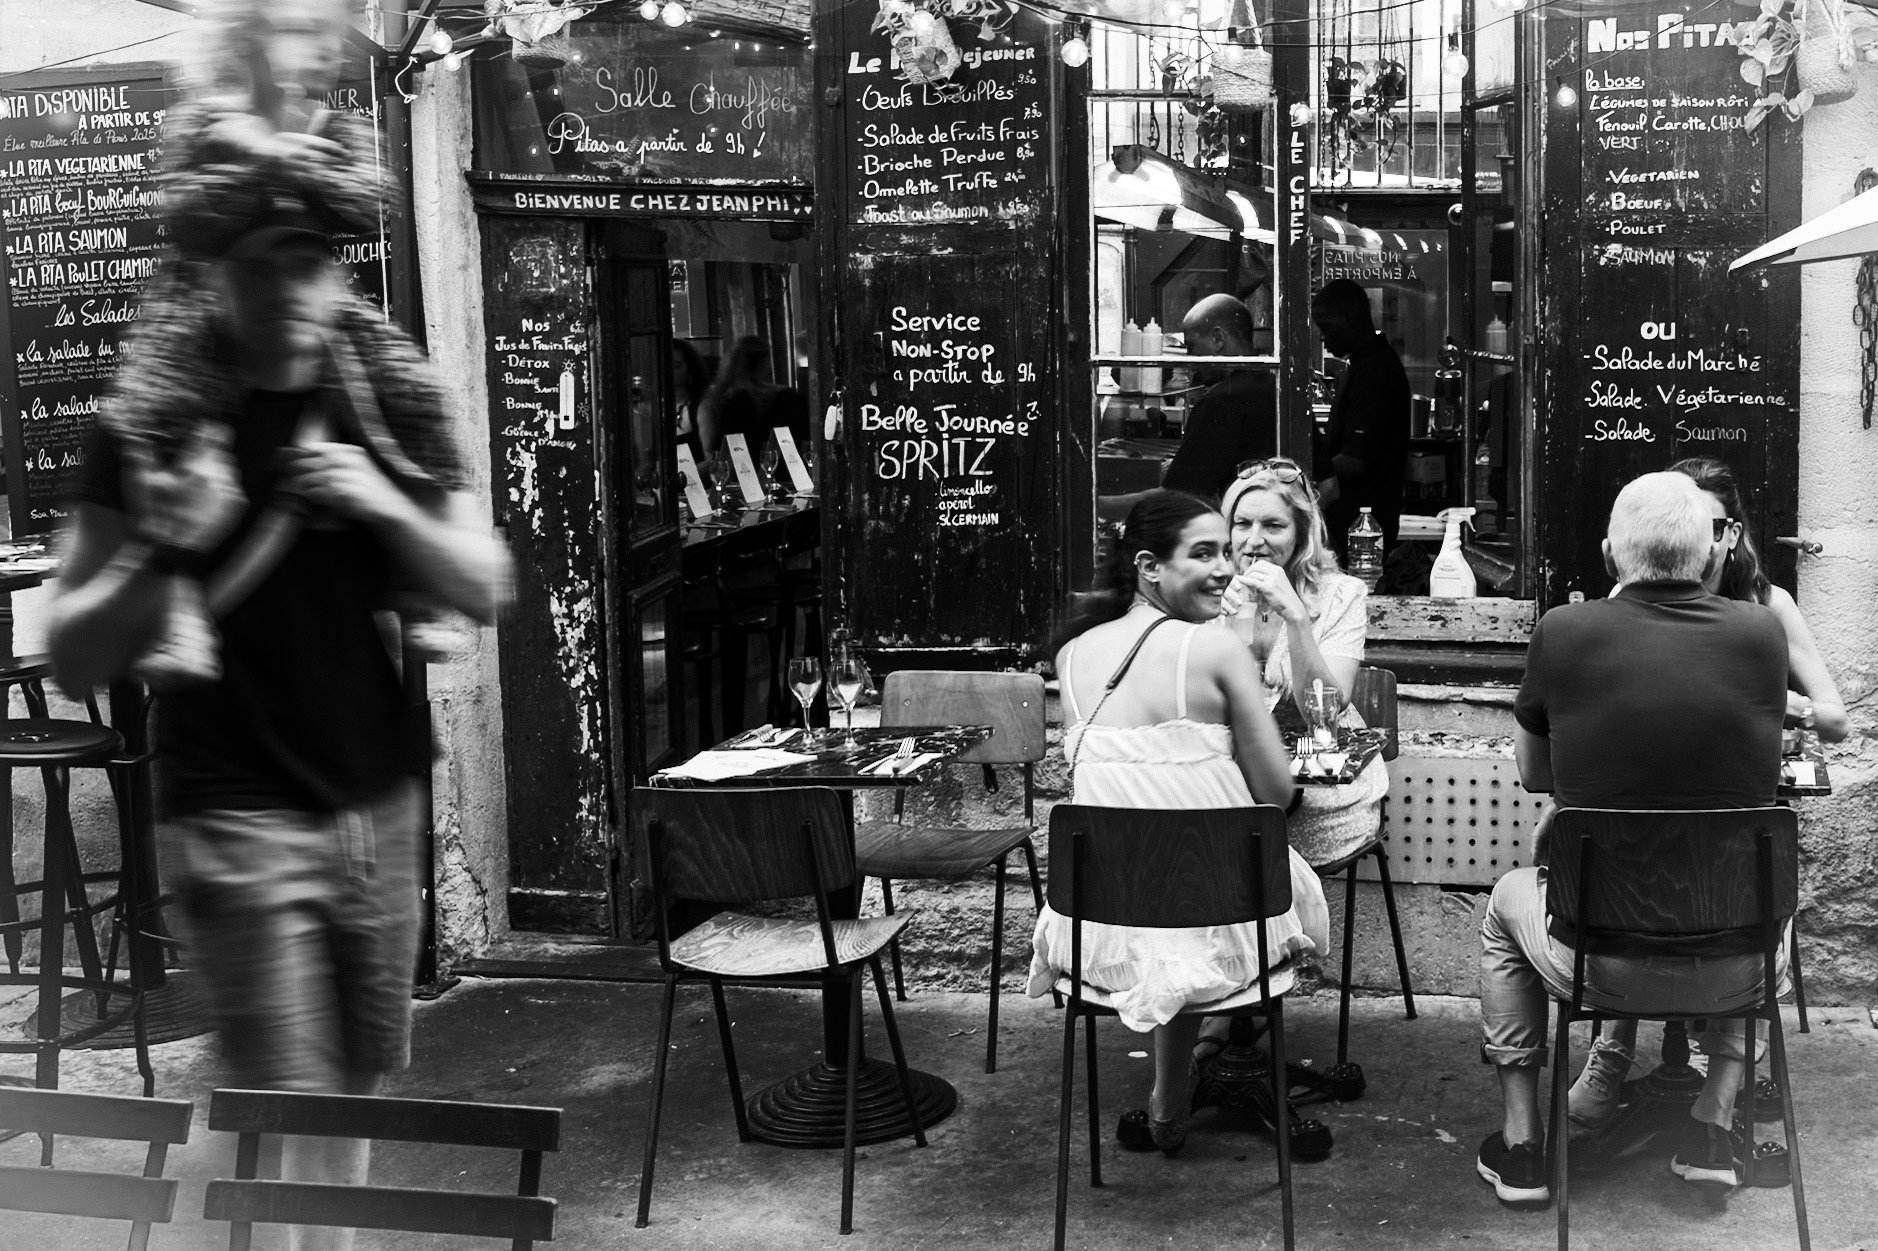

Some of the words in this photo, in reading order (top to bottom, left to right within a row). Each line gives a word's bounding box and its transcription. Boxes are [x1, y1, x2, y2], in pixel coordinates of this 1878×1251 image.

[848, 52, 881, 73] Le
[596, 67, 676, 113] Salle
[690, 70, 793, 130] Chauffée
[135, 111, 150, 126] DE
[131, 127, 157, 141] 2025
[548, 112, 609, 154] Pitas
[636, 128, 688, 164] partir
[696, 133, 714, 153] de
[725, 132, 744, 156] 9h
[864, 123, 925, 147] Salade
[928, 125, 948, 143] de
[1599, 135, 1641, 150] VERT
[1290, 131, 1304, 164] LE
[9, 159, 25, 178] LA
[864, 154, 932, 175] Brioche
[940, 148, 1005, 166] Perdue
[864, 180, 938, 198] Omelette
[941, 172, 998, 191] Truffe
[11, 198, 28, 217] LA
[865, 204, 905, 223] Toast
[911, 209, 930, 219] au
[1289, 176, 1305, 246] CHEF
[16, 236, 33, 254] LA
[69, 227, 127, 251] SAUMON
[18, 268, 37, 287] LA
[521, 318, 550, 333] Nos
[891, 306, 981, 331] Service
[47, 339, 92, 363] salade
[98, 337, 114, 357] du
[495, 335, 517, 351] Jus
[518, 338, 531, 350] de
[1592, 344, 1664, 370] Salade
[1667, 353, 1687, 370] du
[1688, 348, 1762, 372] Marché
[909, 360, 972, 391] partir
[982, 362, 1006, 384] de
[1017, 362, 1036, 382] 9h
[54, 394, 102, 417] salade
[1656, 384, 1786, 413] Végétarienne
[861, 404, 928, 434] Belle
[1593, 418, 1656, 442] Salade
[1676, 420, 1747, 442] Saumon
